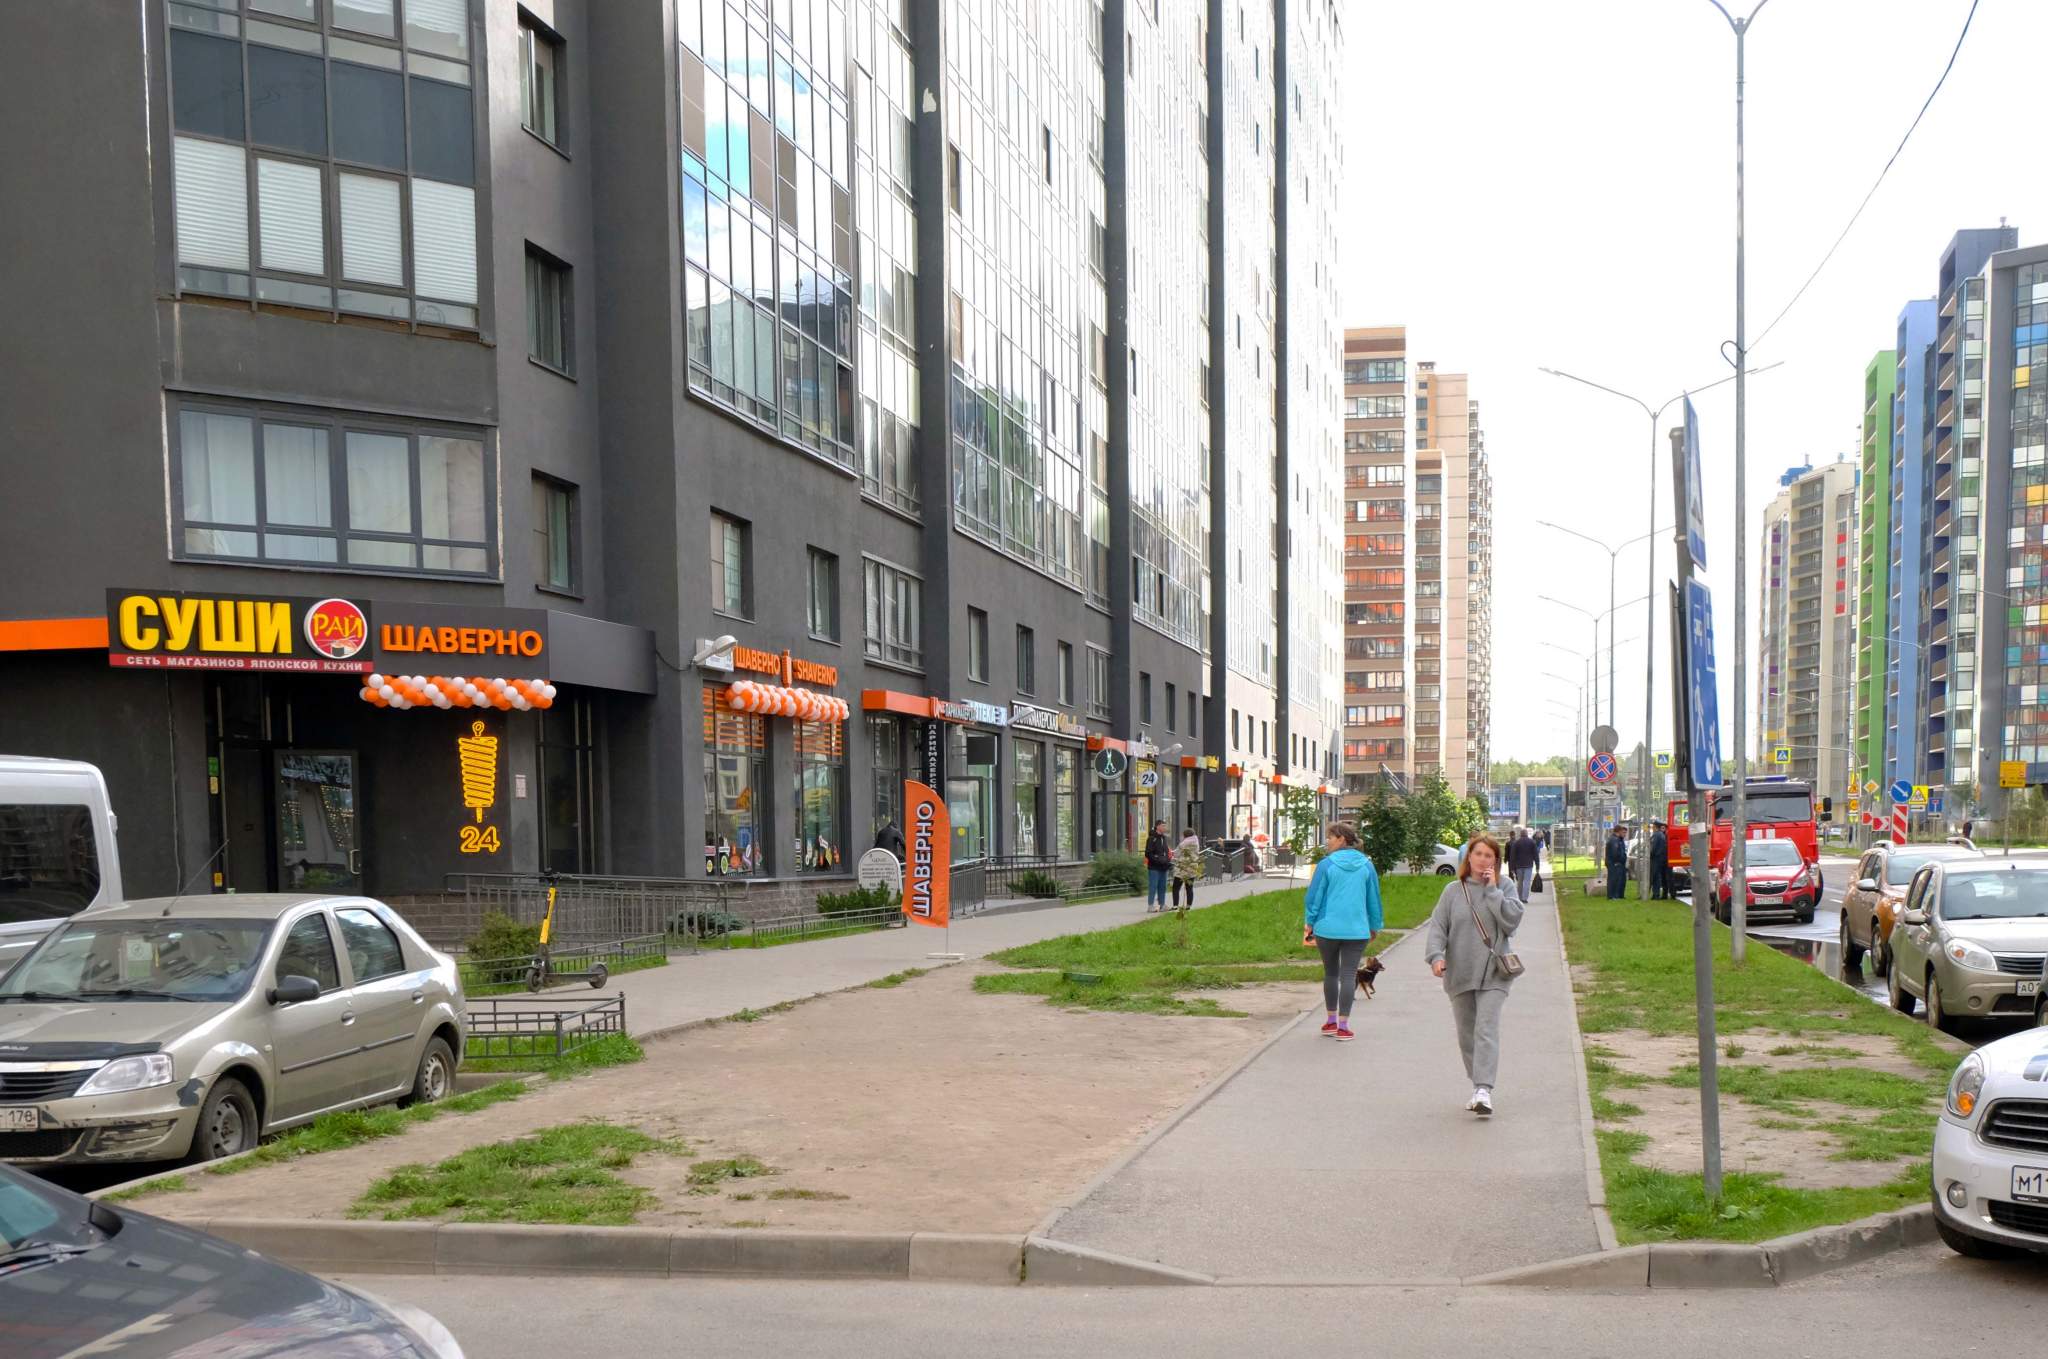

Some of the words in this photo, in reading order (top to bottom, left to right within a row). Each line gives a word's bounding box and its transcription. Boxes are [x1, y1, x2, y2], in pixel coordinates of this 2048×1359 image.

[119, 595, 292, 654] СУШИ
[312, 611, 363, 639] РАЙ
[380, 623, 543, 657] ШАВЕРНО
[126, 656, 160, 666] СЕТЬ
[167, 657, 244, 668] МАГАЗИНОВ
[250, 659, 318, 670] ЯПОНСКОЙ
[323, 661, 363, 671] КУХНИ
[735, 646, 781, 676] ШАВЕРНО
[795, 660, 838, 688] SHAVERNO
[928, 724, 938, 791] ПАРИКМАХЕРСК
[1142, 773, 1155, 785] 24
[460, 825, 500, 853] 24
[912, 803, 934, 917] ШАВЕРНО
[2018, 1173, 2048, 1194] М1
